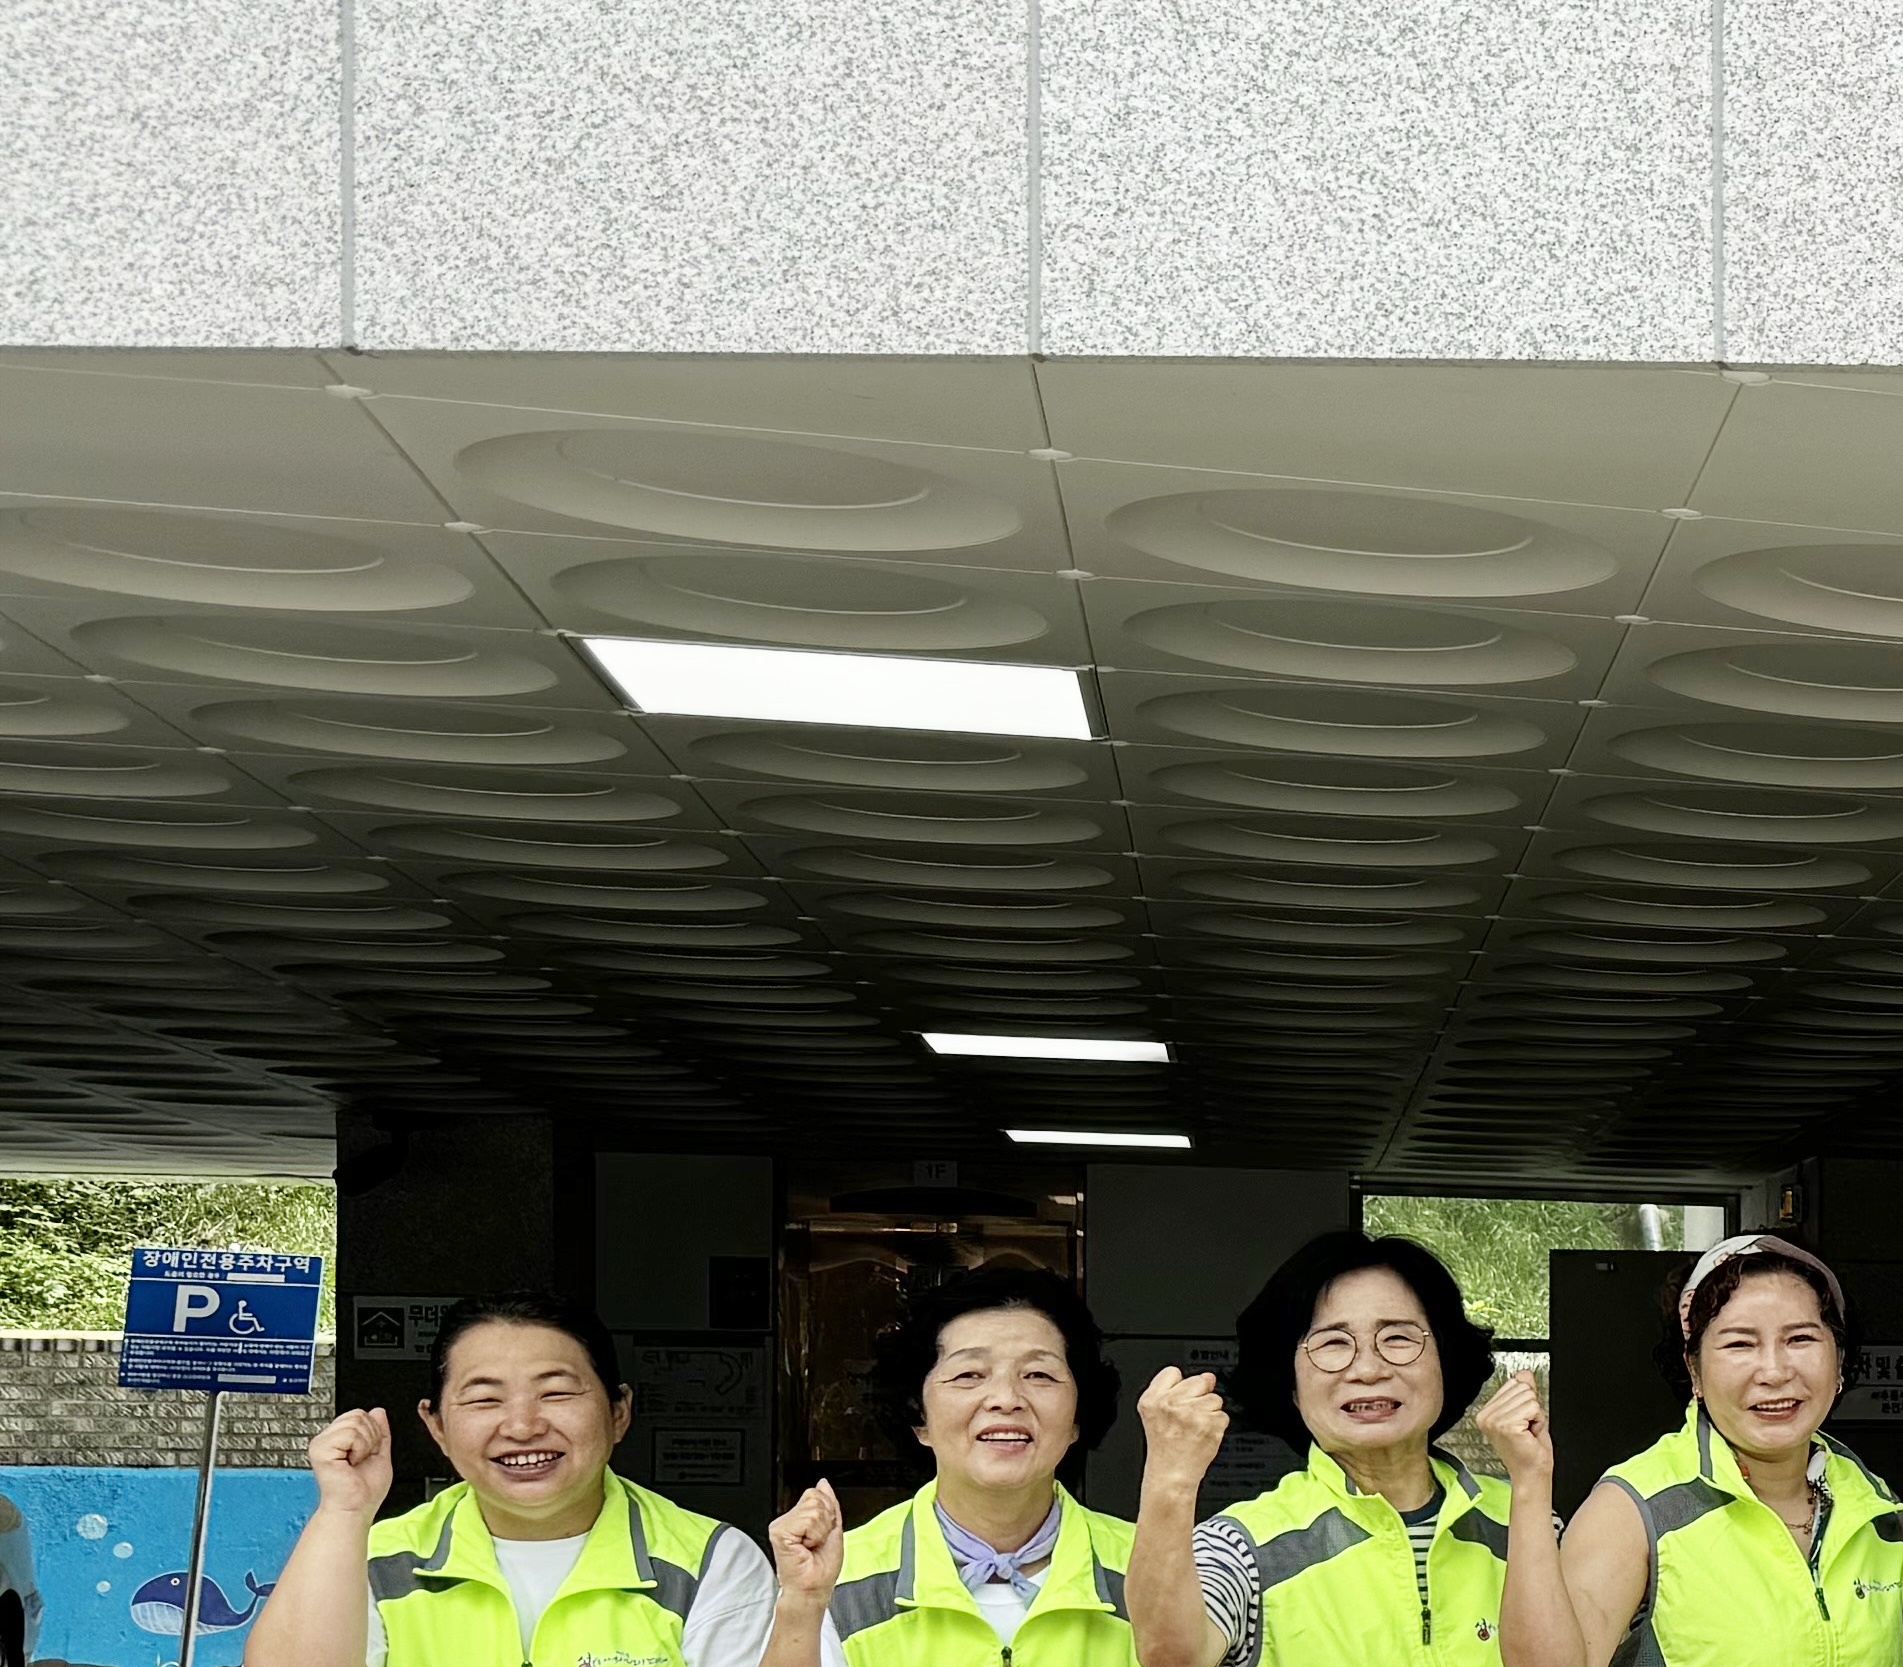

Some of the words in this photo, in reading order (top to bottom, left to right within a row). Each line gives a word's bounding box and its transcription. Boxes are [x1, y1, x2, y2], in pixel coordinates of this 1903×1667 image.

[926, 1164, 946, 1179] 1F
[143, 1250, 310, 1274] 장애인전용주차구역
[173, 1285, 220, 1332] P
